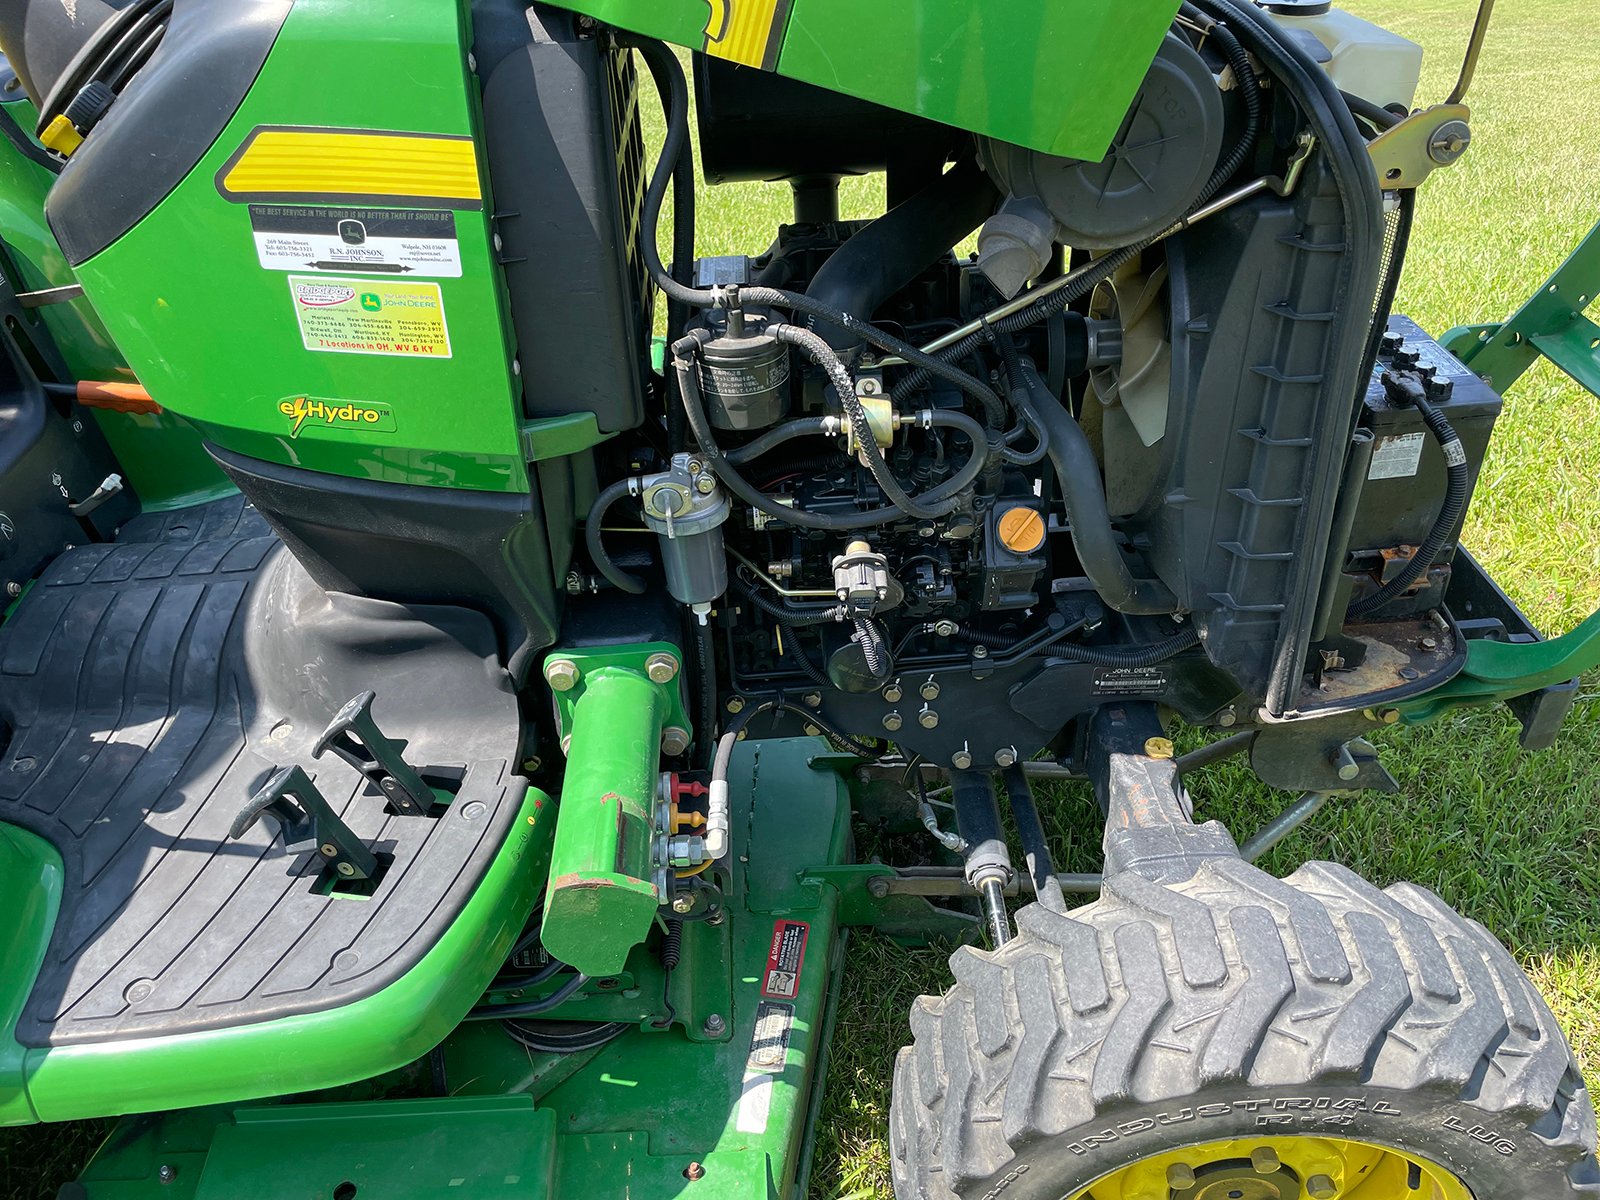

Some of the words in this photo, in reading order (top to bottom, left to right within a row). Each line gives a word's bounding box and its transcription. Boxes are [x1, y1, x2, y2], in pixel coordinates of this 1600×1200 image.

[297, 285, 353, 295] BRIDGEPORT
[326, 340, 365, 349] Locations
[772, 931, 781, 954] DANGER
[778, 945, 786, 966] ROTATING
[1066, 1096, 1402, 1156] INDUSTRIAL
[1254, 1113, 1356, 1127] R-4
[1442, 1114, 1517, 1156] LUG
